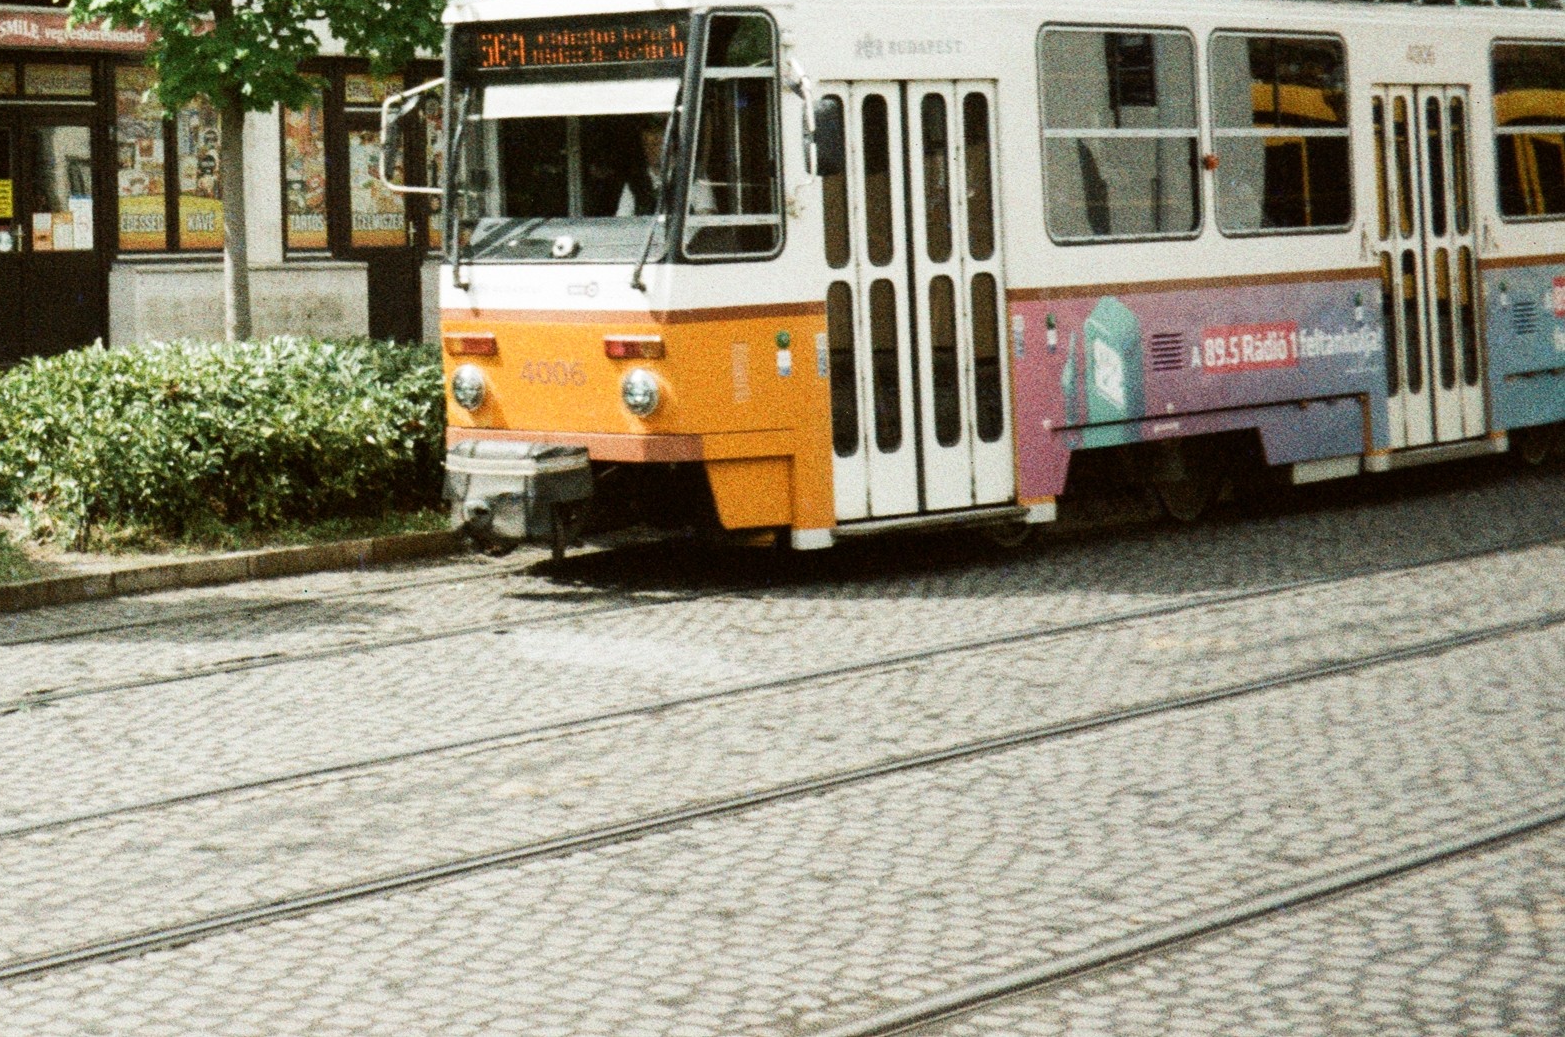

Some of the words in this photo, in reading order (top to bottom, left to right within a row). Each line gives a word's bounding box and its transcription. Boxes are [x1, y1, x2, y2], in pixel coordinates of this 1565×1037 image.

[1191, 346, 1203, 369] A
[1204, 336, 1240, 367] 89.5
[1241, 331, 1288, 363] Rádió
[521, 360, 588, 387] 4006
